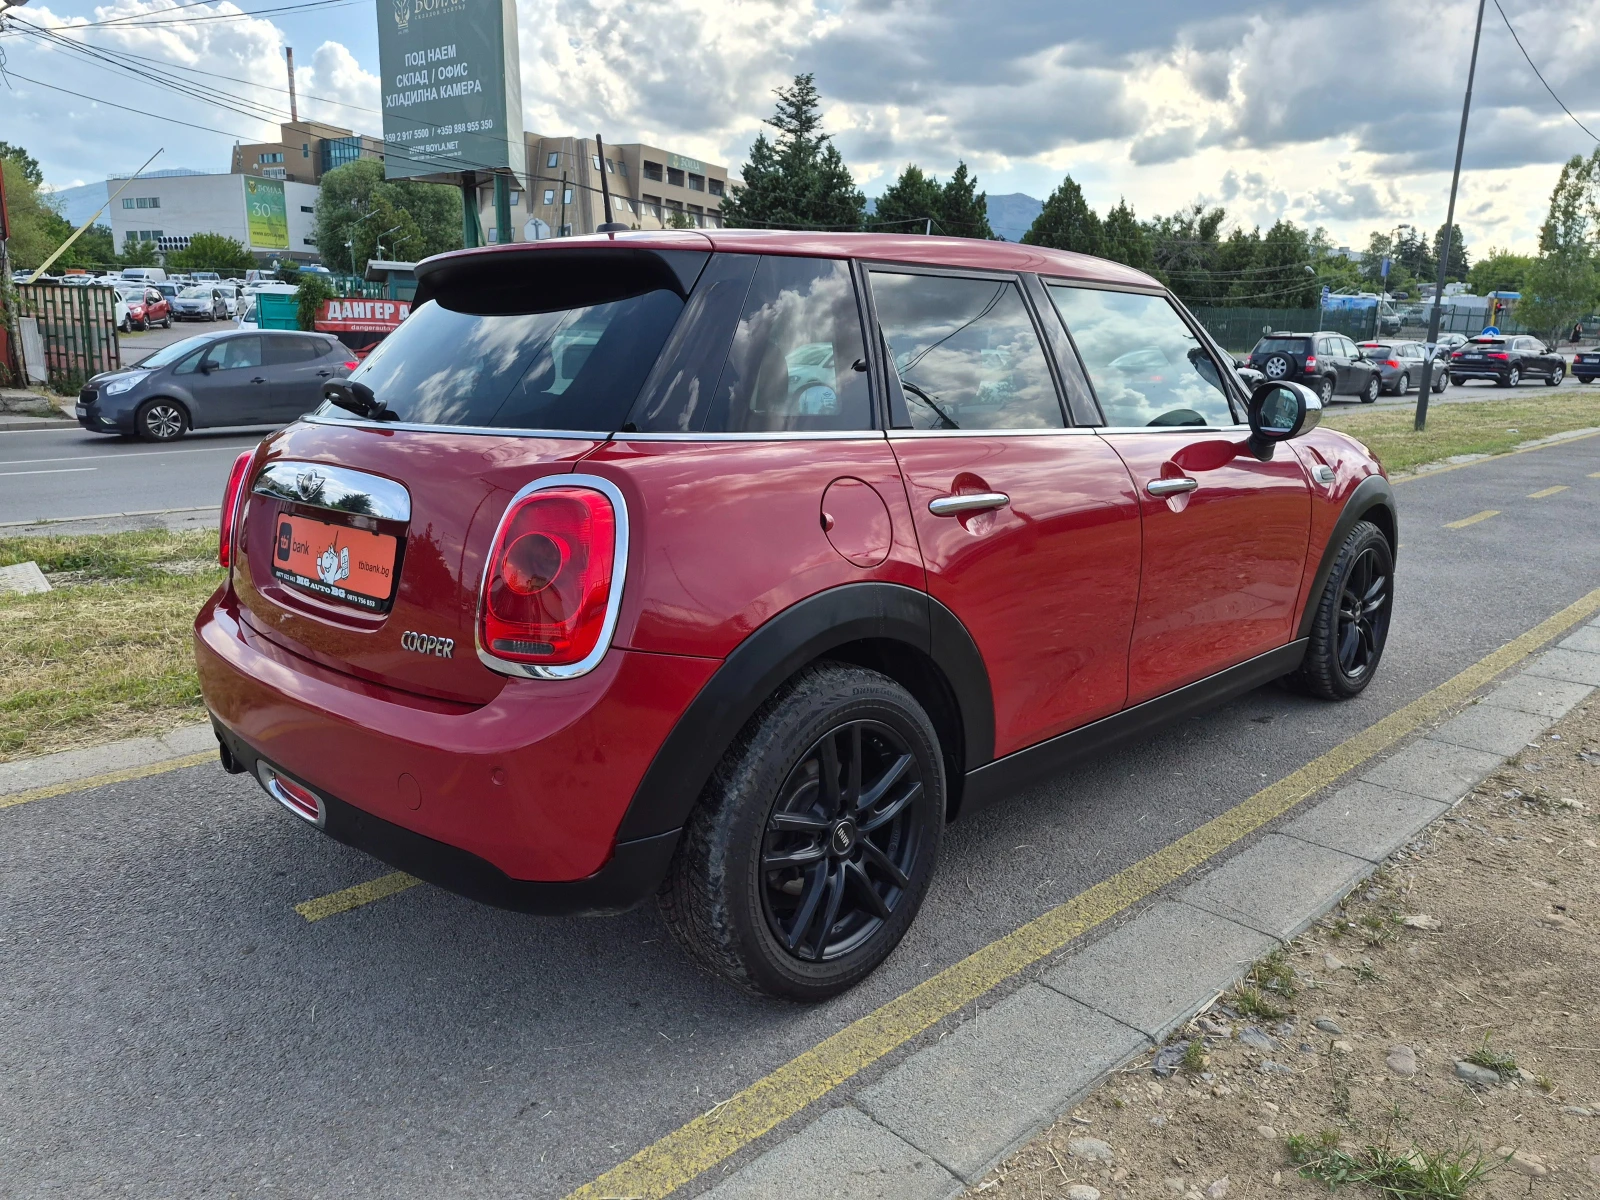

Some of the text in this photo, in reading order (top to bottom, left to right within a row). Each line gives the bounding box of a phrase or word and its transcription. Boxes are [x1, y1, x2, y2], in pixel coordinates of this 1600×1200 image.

[405, 44, 457, 67] ПОД НАЕМ
[396, 62, 468, 88] СКЛАД / ОФИС
[385, 79, 482, 108] ХЛАДИЛНА КАМЕРА
[396, 131, 401, 141] 2
[402, 130, 412, 140] 917
[414, 128, 429, 139] 5500
[437, 125, 453, 136] +359
[453, 122, 466, 134] 888
[467, 121, 479, 132] 955
[480, 119, 493, 130] 350
[253, 202, 271, 217] 30
[328, 301, 412, 320] ДАНГЕР А
[292, 538, 309, 555] bank
[358, 561, 390, 577] tbibank.bg
[296, 575, 311, 587] MG
[311, 583, 331, 593] AUTO
[331, 586, 346, 598] BG
[400, 630, 454, 659] COOPER
